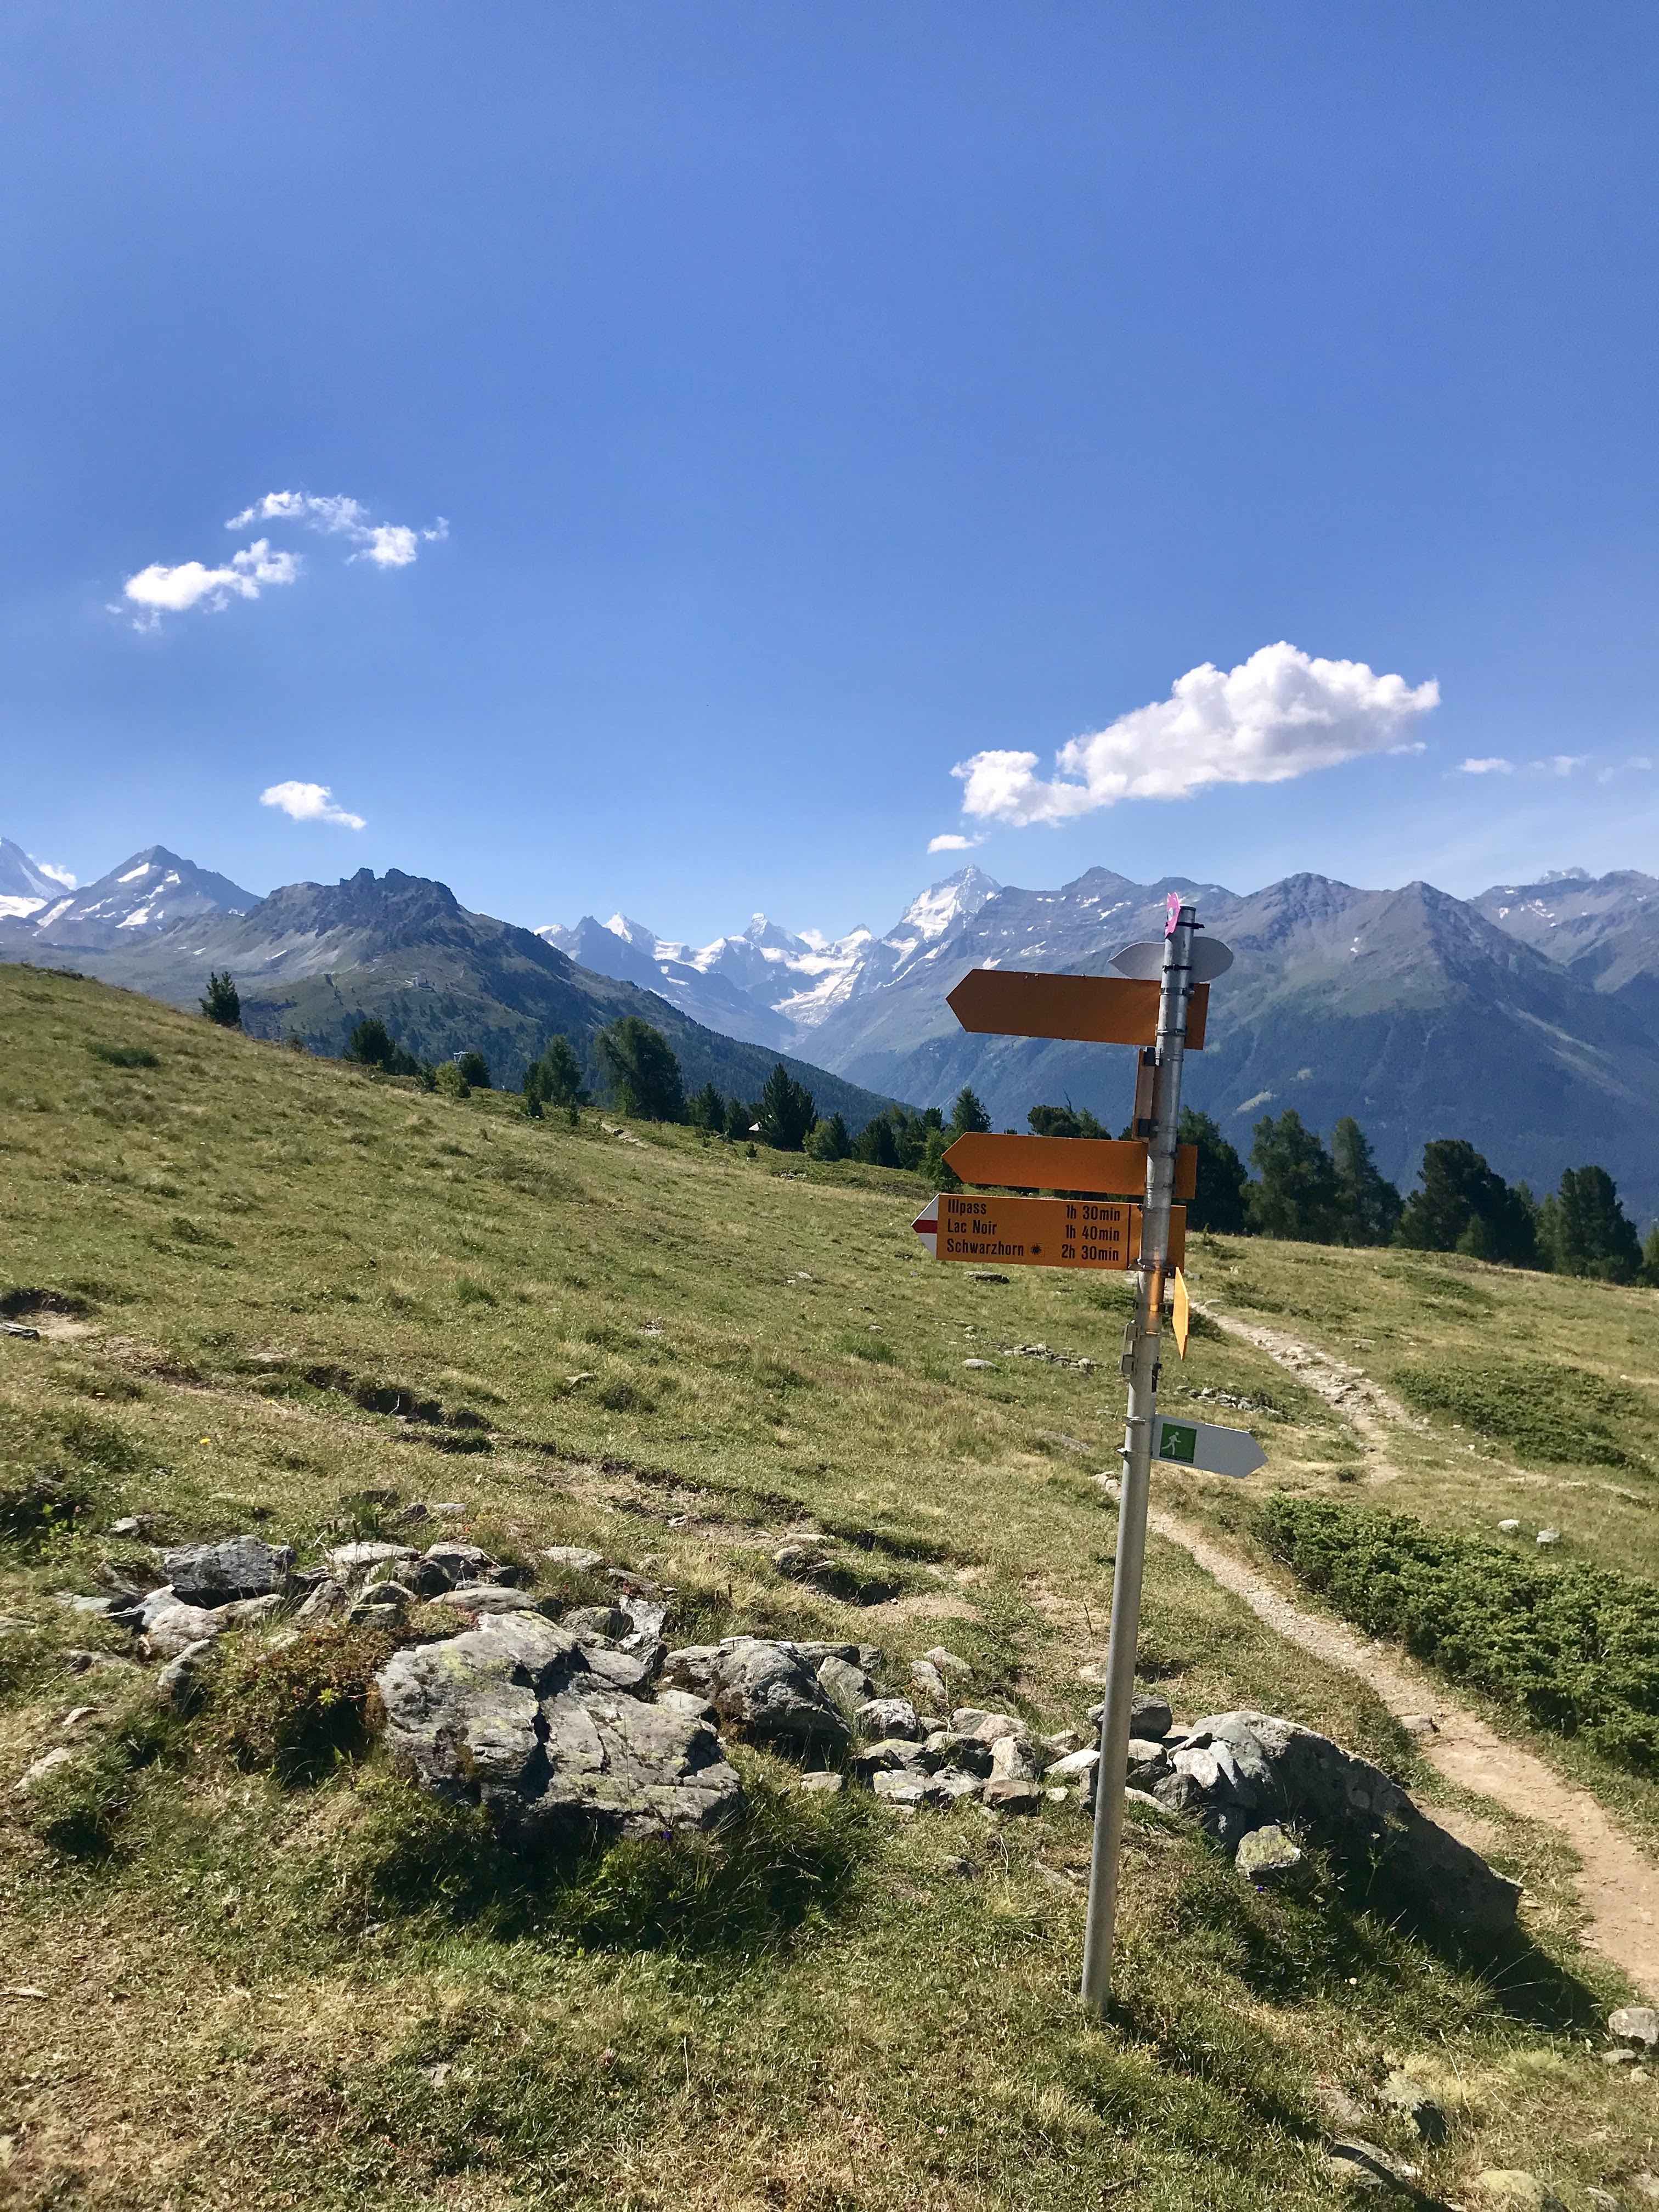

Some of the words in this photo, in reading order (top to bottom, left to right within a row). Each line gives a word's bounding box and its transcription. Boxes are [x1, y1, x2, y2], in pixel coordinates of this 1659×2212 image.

[947, 1199, 987, 1216] Illpass
[1066, 1204, 1077, 1220] 1h
[947, 1218, 967, 1234] Lac
[972, 1220, 997, 1235] Noir
[1065, 1224, 1076, 1239] 1h
[947, 1238, 1024, 1256] Schwarzhorn
[1062, 1244, 1075, 1259] 2h
